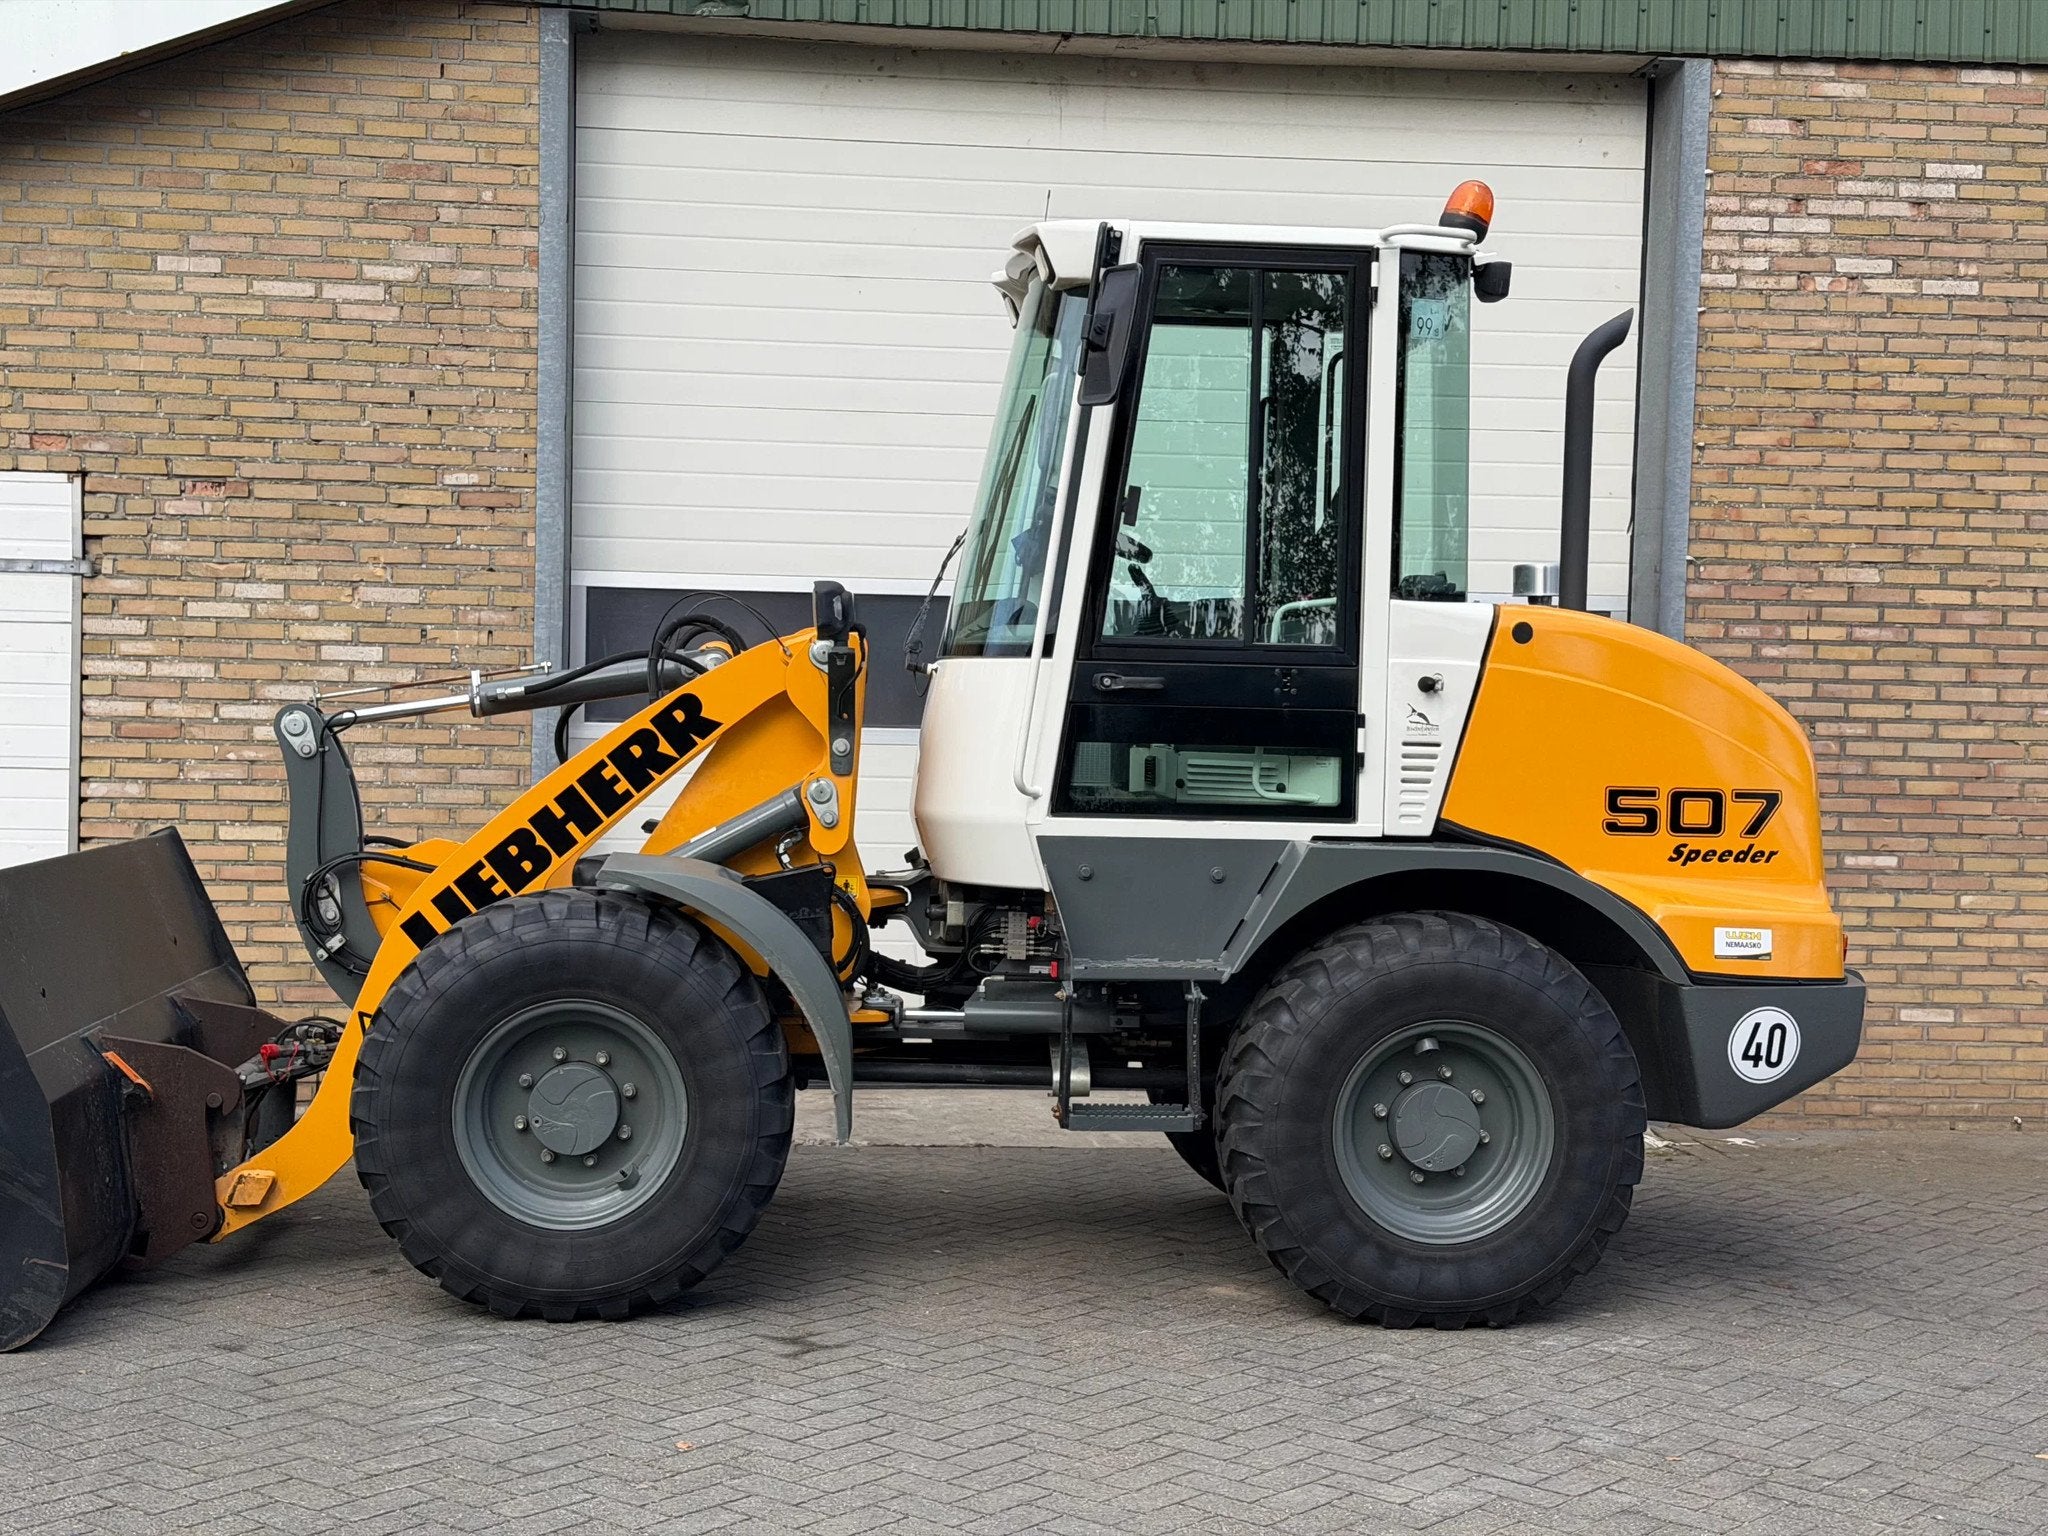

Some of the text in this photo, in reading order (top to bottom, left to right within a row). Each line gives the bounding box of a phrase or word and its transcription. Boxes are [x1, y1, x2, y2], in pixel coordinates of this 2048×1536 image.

[1416, 316, 1433, 335] 99
[1602, 786, 1782, 839] 507
[1667, 843, 1779, 867] Speeder
[1741, 1022, 1787, 1068] 40
